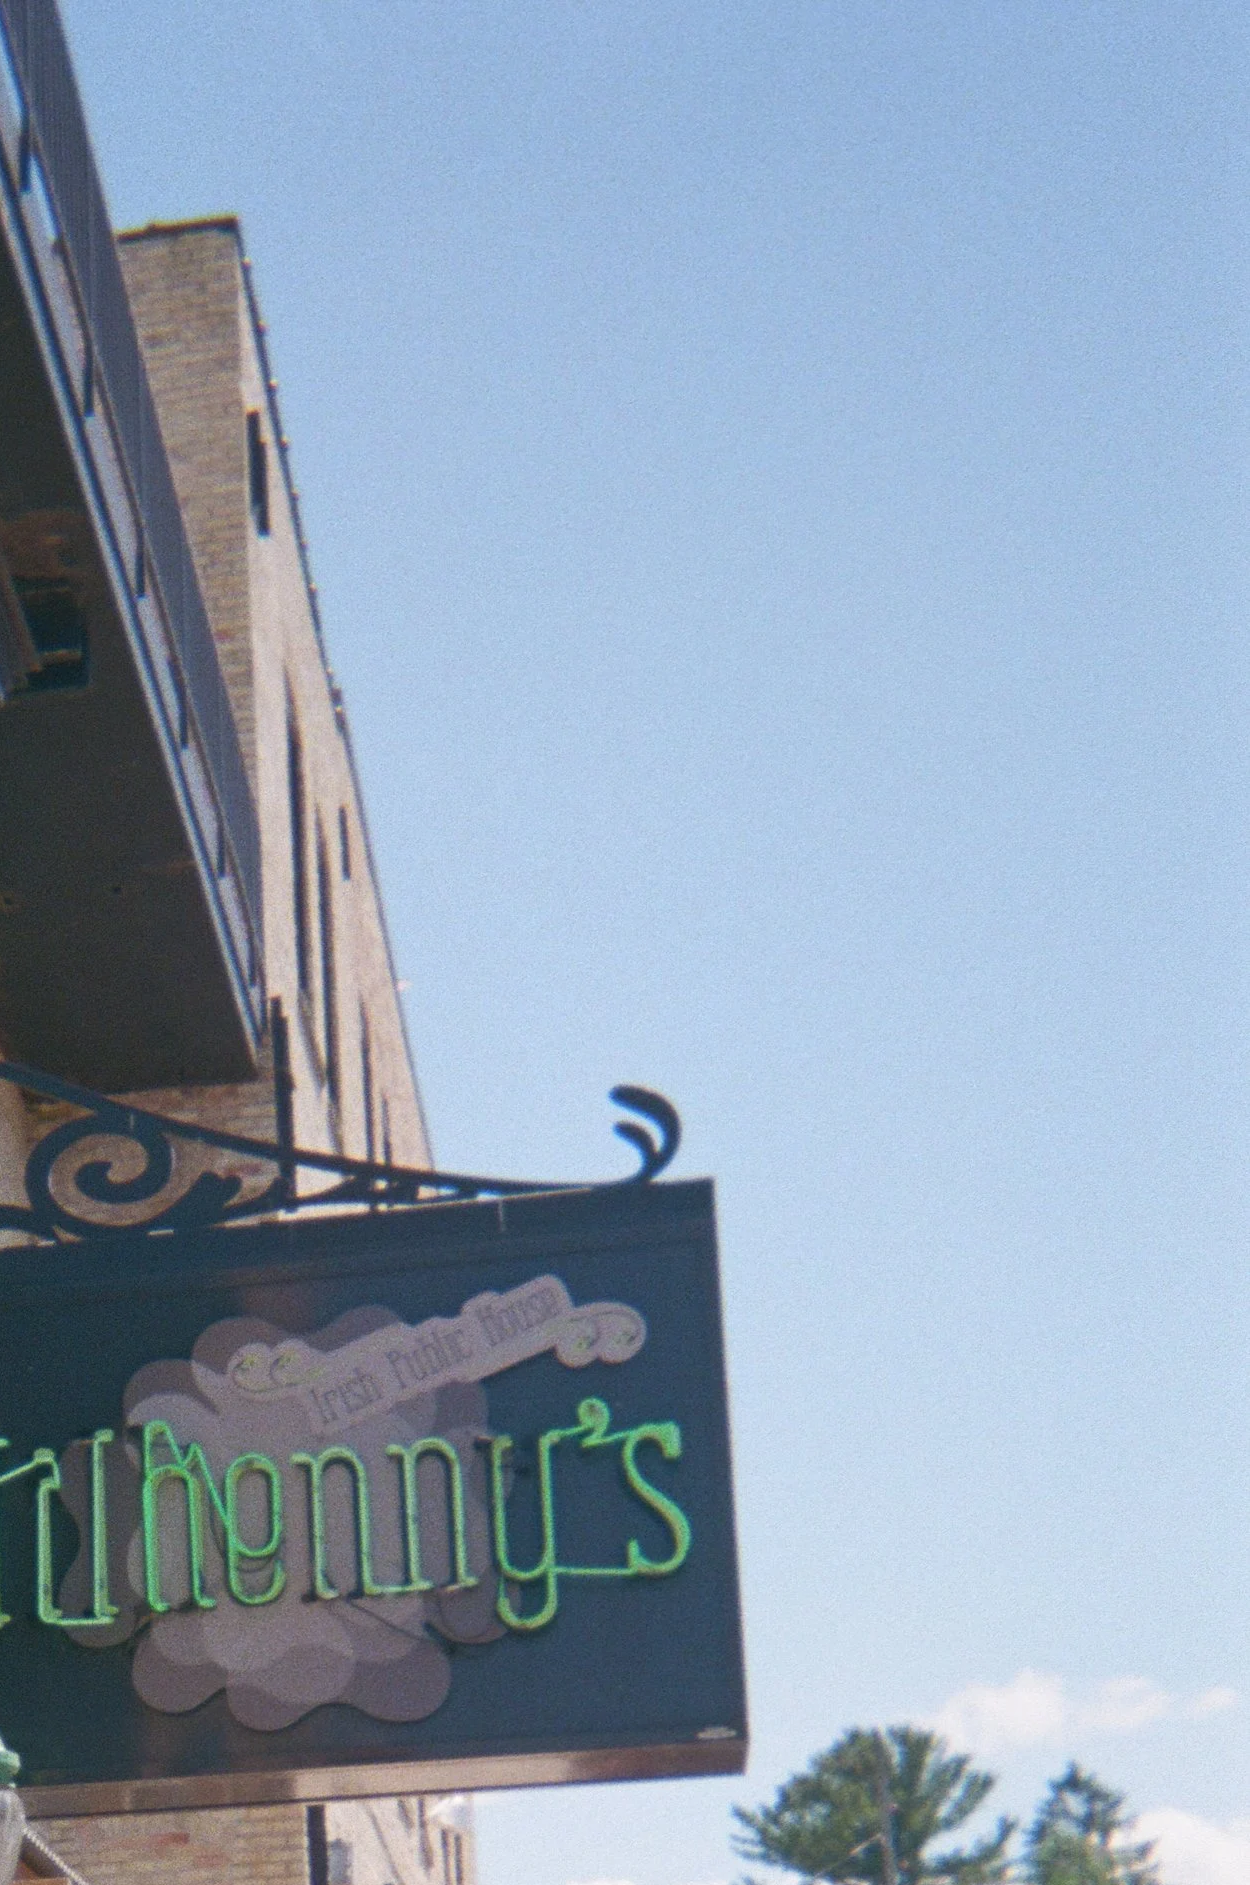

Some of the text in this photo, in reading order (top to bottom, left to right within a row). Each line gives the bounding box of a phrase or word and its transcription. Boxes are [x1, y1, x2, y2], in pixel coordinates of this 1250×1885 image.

[309, 1286, 561, 1424] Irish Public House
